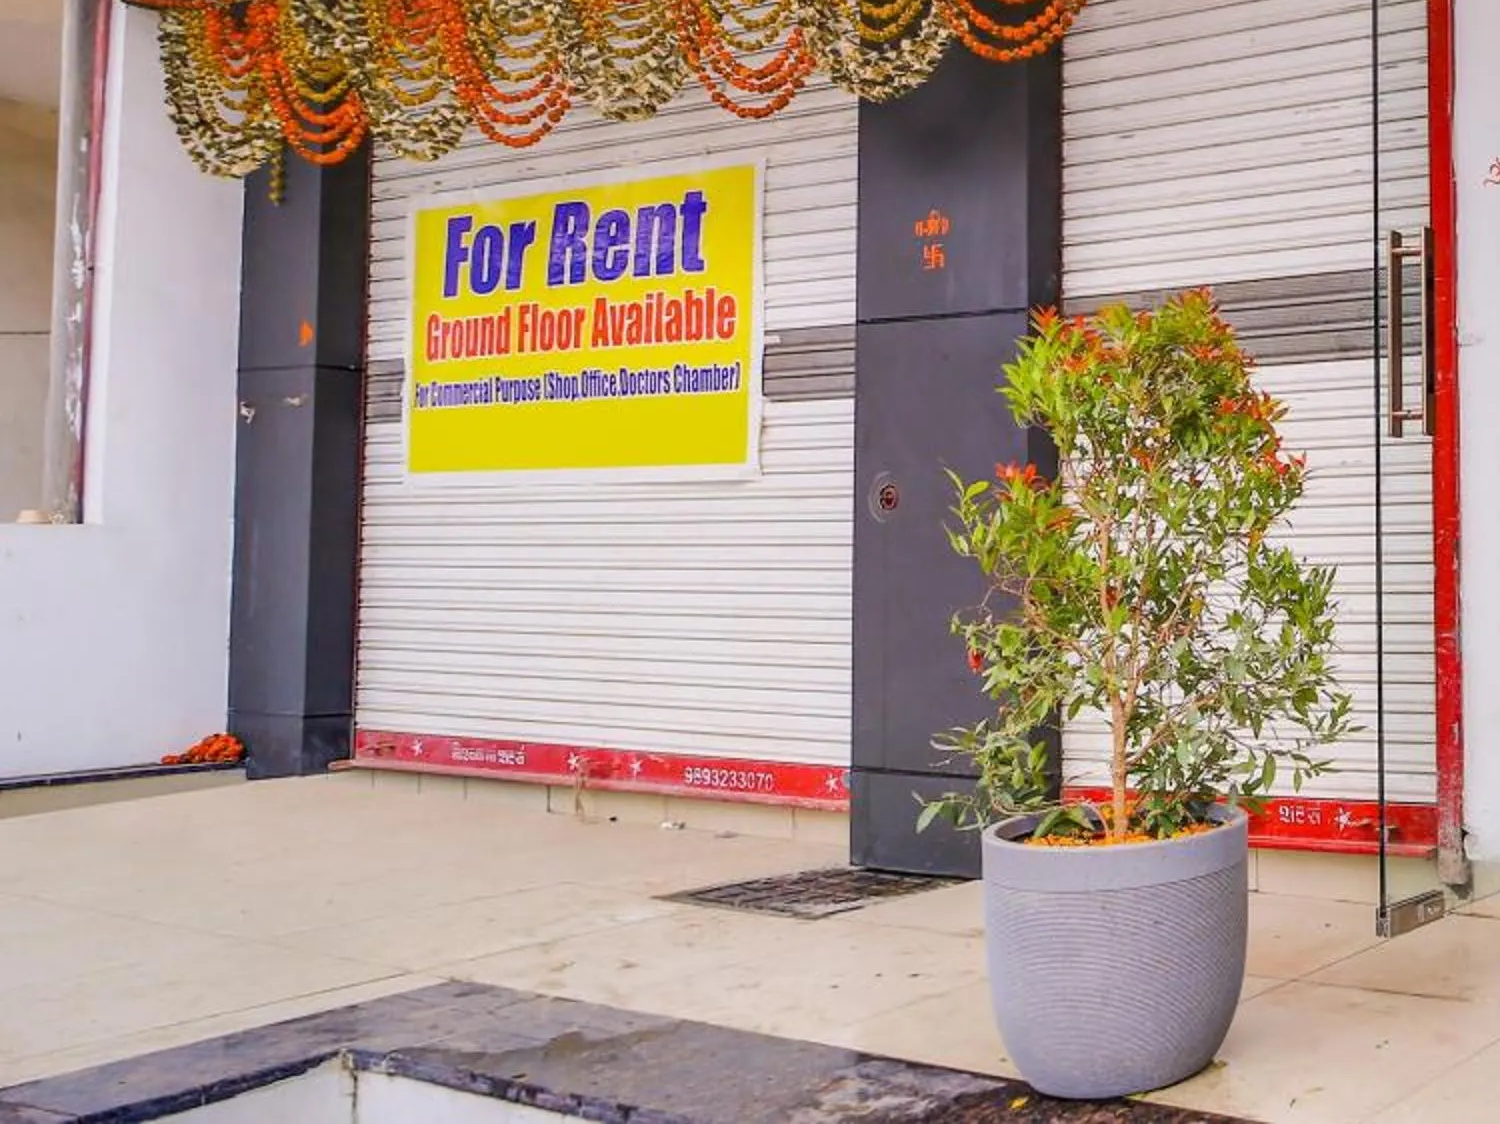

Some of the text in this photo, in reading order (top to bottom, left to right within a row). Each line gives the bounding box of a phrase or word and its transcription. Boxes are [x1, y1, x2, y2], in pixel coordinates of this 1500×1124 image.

[442, 190, 707, 298] For Rent
[426, 287, 737, 362] Ground Floor Available
[415, 383, 430, 408] For
[431, 377, 493, 408] Commercial
[495, 375, 541, 405] Purpose
[673, 362, 742, 394] Chamber)
